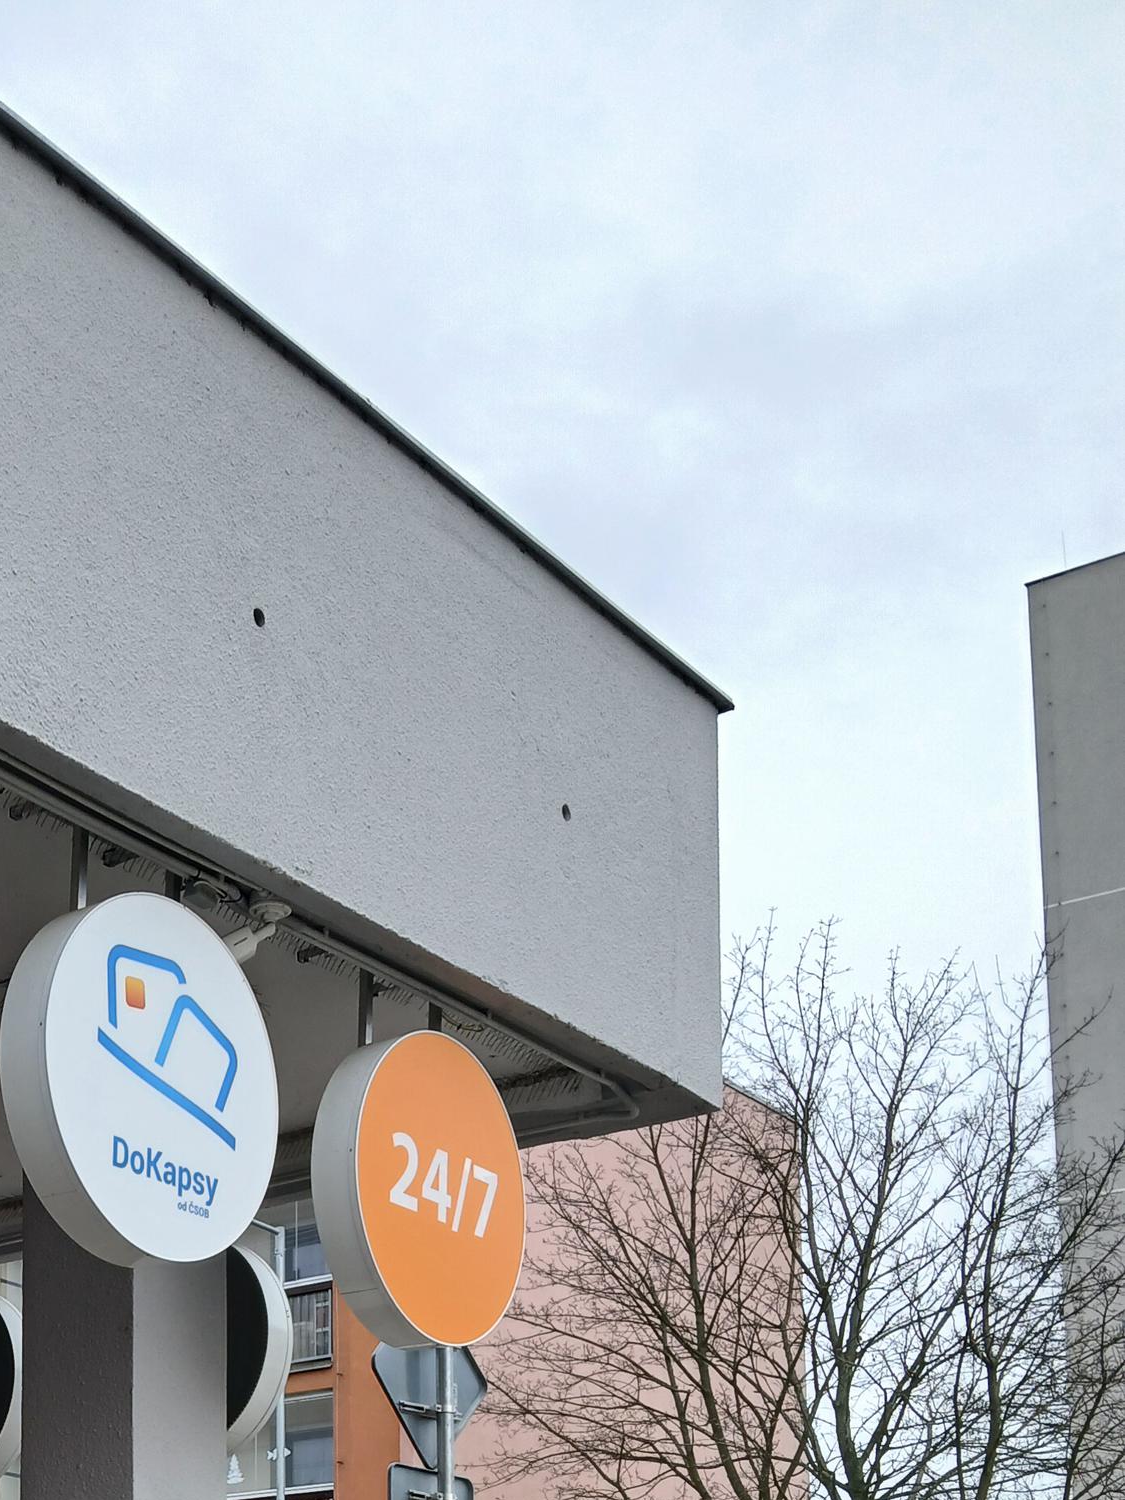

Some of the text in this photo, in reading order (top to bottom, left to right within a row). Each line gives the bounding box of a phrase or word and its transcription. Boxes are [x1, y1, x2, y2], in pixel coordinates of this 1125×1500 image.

[111, 1135, 218, 1206] DoKapsy
[389, 1131, 498, 1239] 24/7
[177, 1200, 210, 1219] od ČSOB
